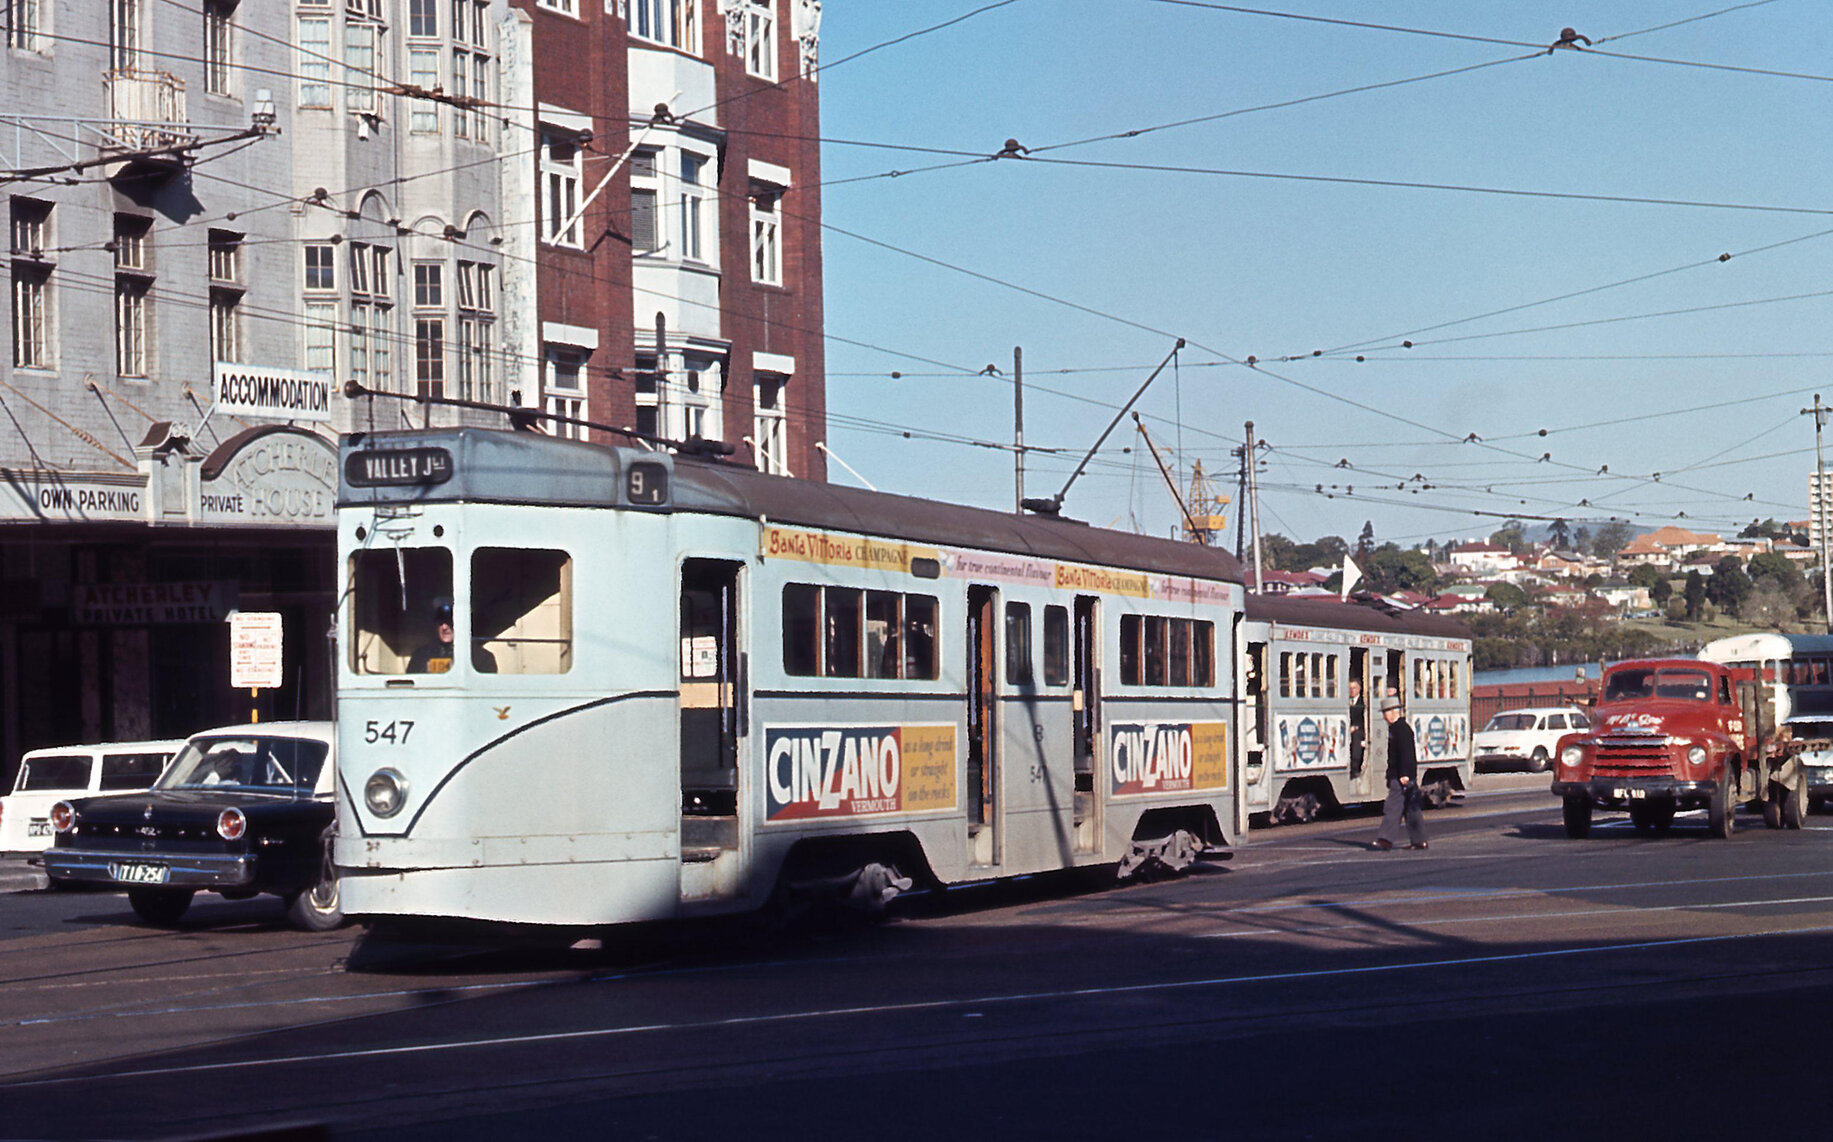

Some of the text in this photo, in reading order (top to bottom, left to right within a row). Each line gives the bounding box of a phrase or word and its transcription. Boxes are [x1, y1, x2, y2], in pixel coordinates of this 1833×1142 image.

[219, 373, 329, 413] ACCOMMODATION
[233, 442, 337, 496] ATCHERLE
[365, 457, 418, 479] VALLEY
[631, 471, 644, 495] 9
[40, 488, 140, 513] OWN PARKING
[201, 495, 245, 513] PRIVATE
[251, 489, 326, 517] HOUSE
[854, 544, 908, 565] CHAMPAGNE
[968, 560, 983, 573] true
[984, 561, 1025, 577] continental
[85, 583, 212, 605] ATCHERLEY
[83, 605, 217, 623] PRIVATE HOTEL
[364, 720, 415, 744] 547
[1112, 725, 1192, 788] CINZANO
[768, 731, 900, 810] CINZANO
[851, 798, 897, 813] VERMOUTH
